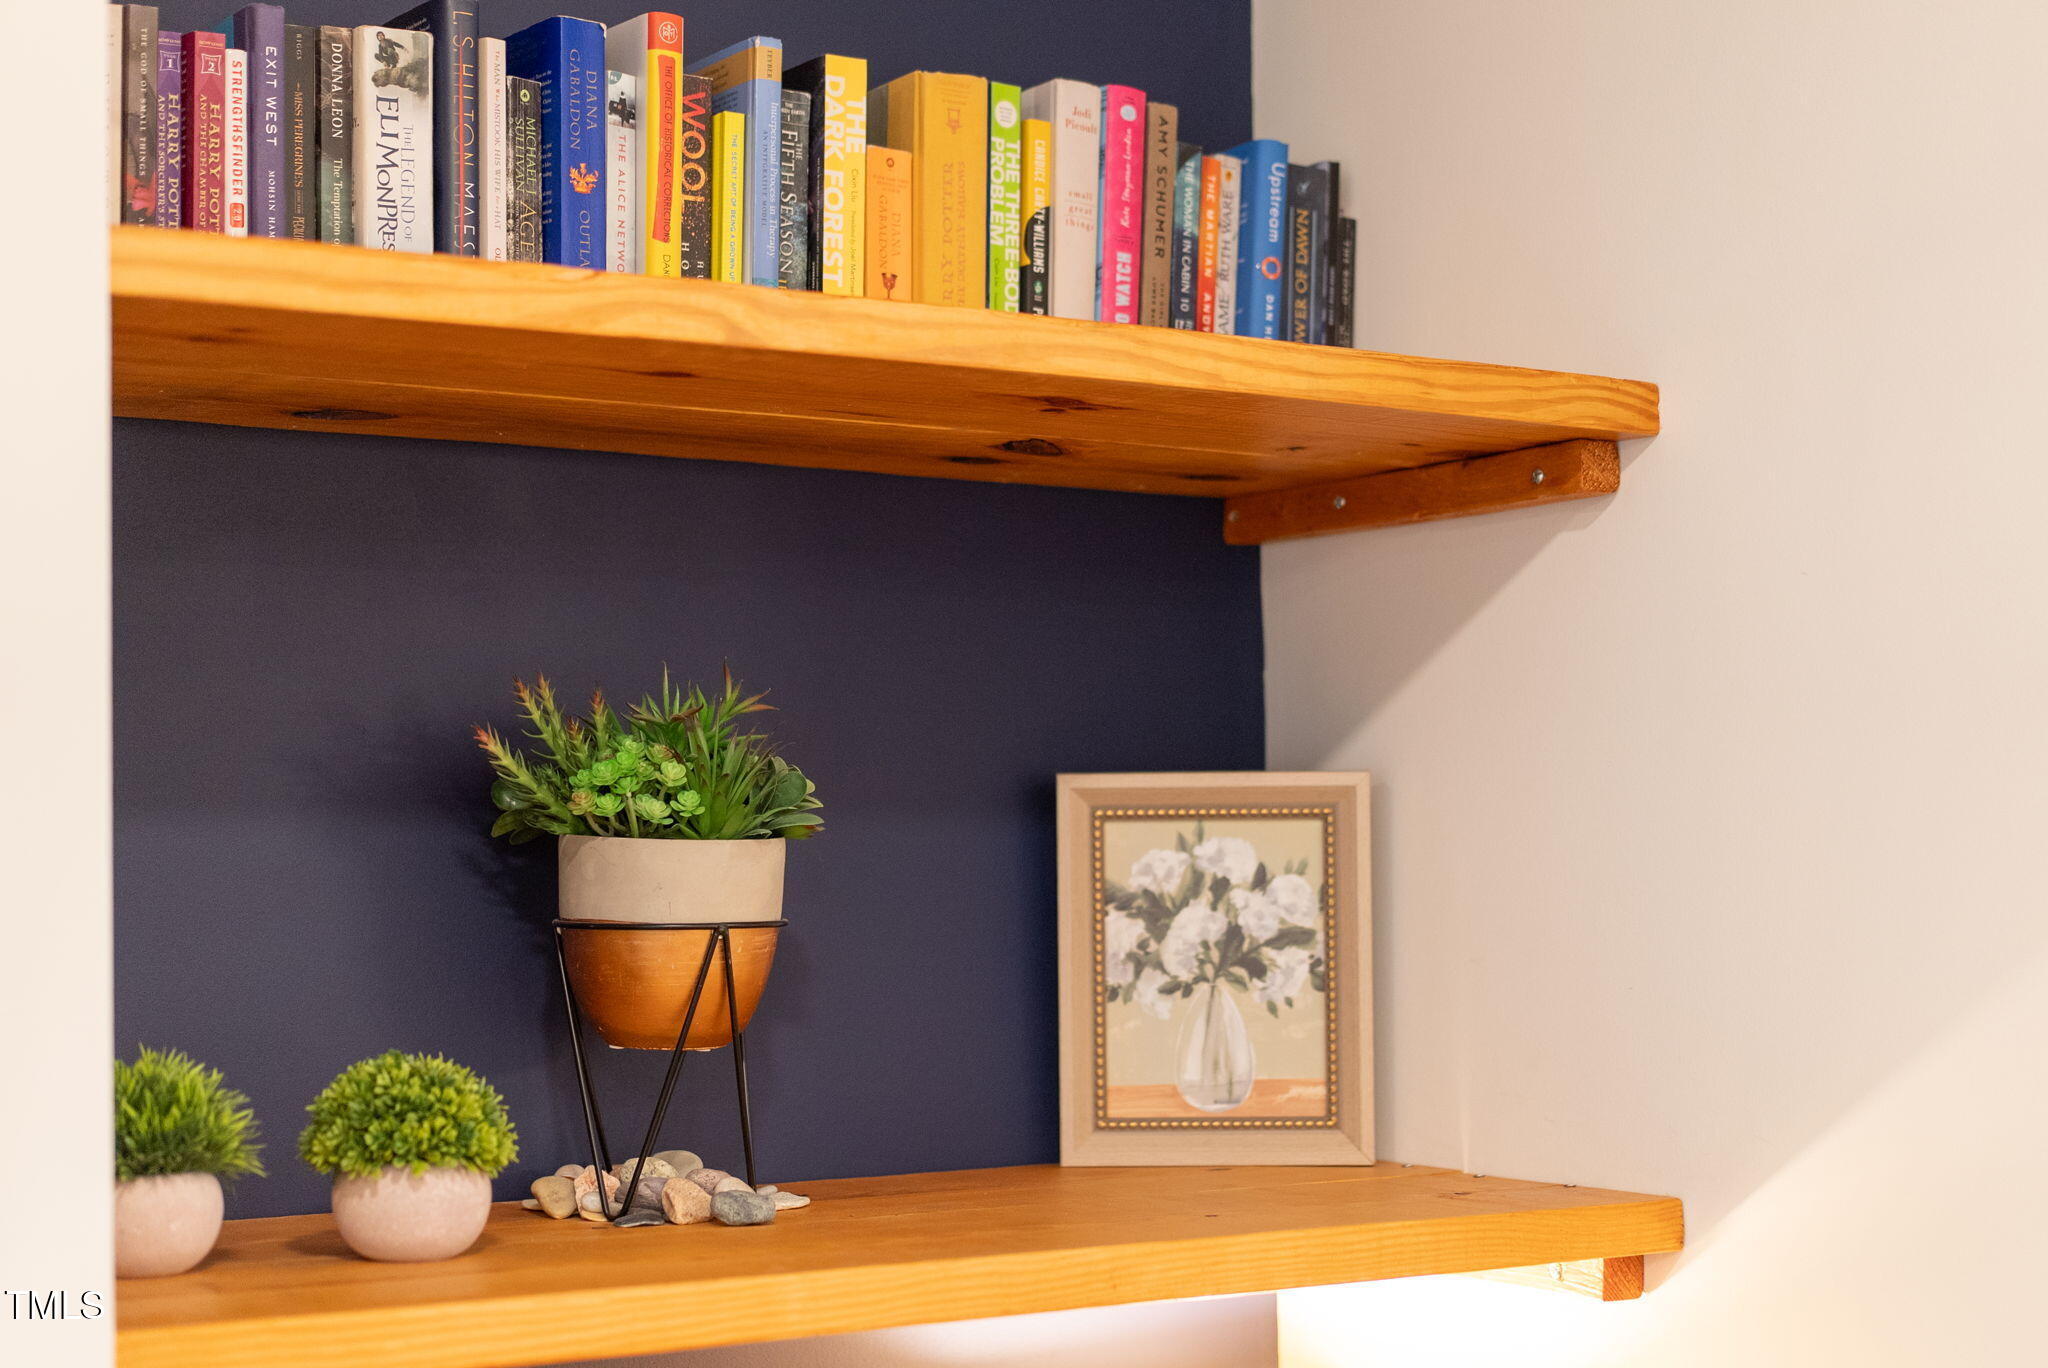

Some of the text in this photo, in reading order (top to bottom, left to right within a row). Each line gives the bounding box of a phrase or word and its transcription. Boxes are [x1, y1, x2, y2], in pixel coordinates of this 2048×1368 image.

[452, 11, 474, 24] L.
[452, 36, 474, 52] S.
[140, 80, 147, 92] OF
[266, 46, 278, 146] EXIT WEST
[294, 91, 304, 116] MISS
[331, 43, 343, 138] DONNA LEON
[570, 49, 581, 150] GABALDON
[586, 70, 598, 130] DIANA
[1072, 106, 1092, 119] Jodi
[166, 92, 180, 169] HARRY
[208, 103, 222, 180] HARRY
[232, 60, 243, 196] STRENGTHSFINDER
[376, 95, 399, 139] ELI
[452, 64, 474, 166] HILTON
[664, 112, 672, 124] OF
[762, 130, 768, 142] AN
[846, 96, 866, 152] THE
[1065, 118, 1098, 135] Picoult
[138, 137, 146, 176] THINGS
[294, 119, 304, 188] PEREGRINE'S
[333, 158, 342, 178] The
[514, 118, 524, 192] SULLIVAN
[526, 117, 536, 182] MICHAEL
[664, 128, 672, 178] HISTORICAL
[682, 92, 706, 212] WOOL
[782, 129, 798, 186] FIFTH
[1006, 140, 1020, 188] THE
[1184, 160, 1195, 184] THE
[198, 150, 207, 208] CHAMBER
[268, 170, 276, 212] MOHSIN
[400, 125, 415, 242] THE LEGEND OF
[616, 136, 626, 273] THE ALICE NETWO
[730, 198, 738, 208] OF
[766, 102, 778, 258] Interpersonal Process in Therapy
[822, 74, 846, 288] DARK FOREST
[942, 162, 954, 244] POTTER
[956, 160, 966, 220] HALLOWS
[990, 136, 1004, 246] PROBLEM
[1068, 190, 1092, 200] small
[1154, 116, 1168, 259] AMY SCHUMER
[1206, 176, 1216, 202] THE
[1268, 162, 1286, 243] Upstream
[200, 212, 206, 228] OF
[331, 180, 342, 232] Temptation
[520, 202, 537, 252] AGE
[663, 182, 672, 243] CORRECTIONS
[878, 194, 888, 270] GABALDON
[1033, 140, 1046, 273] CANDICE CARTY-WILLIAMS
[1068, 206, 1093, 216] great
[1120, 206, 1131, 228] Kate
[1182, 188, 1194, 237] WOMAN
[1220, 190, 1234, 233] WARE
[780, 192, 798, 274] SEASON
[891, 212, 902, 257] DIANA
[956, 224, 966, 282] DEATHLY
[1182, 240, 1191, 254] IN
[1204, 209, 1214, 278] MARTIAN
[1295, 208, 1310, 264] DAWN
[1116, 252, 1132, 306] WATCH
[1180, 256, 1191, 294] CABIN
[1219, 240, 1231, 282] RUTH
[1295, 272, 1308, 294] OF
[1180, 298, 1189, 312] 10
[1265, 294, 1274, 322] DAN
